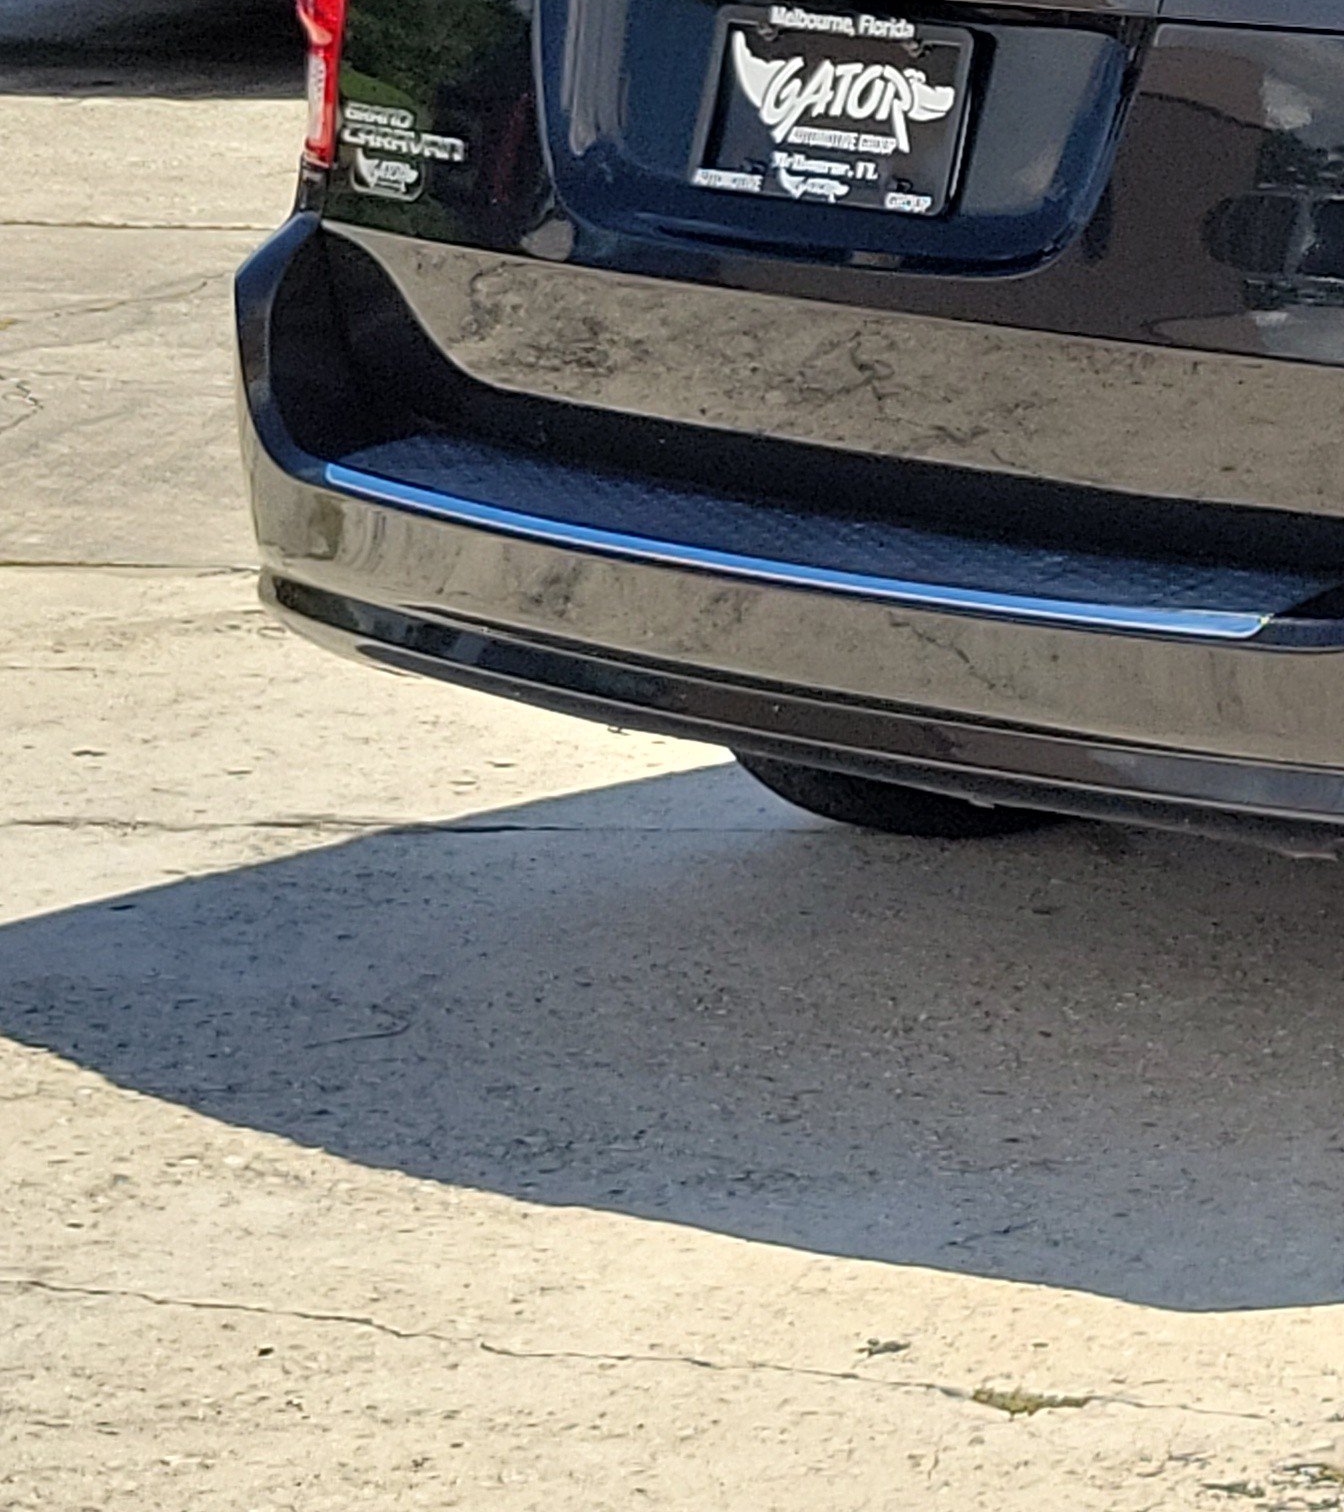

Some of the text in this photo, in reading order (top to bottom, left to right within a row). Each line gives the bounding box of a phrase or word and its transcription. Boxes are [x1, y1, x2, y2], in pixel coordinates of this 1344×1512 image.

[859, 13, 915, 39] Florida
[758, 56, 911, 154] GATOR
[341, 120, 466, 162] CARAVAN
